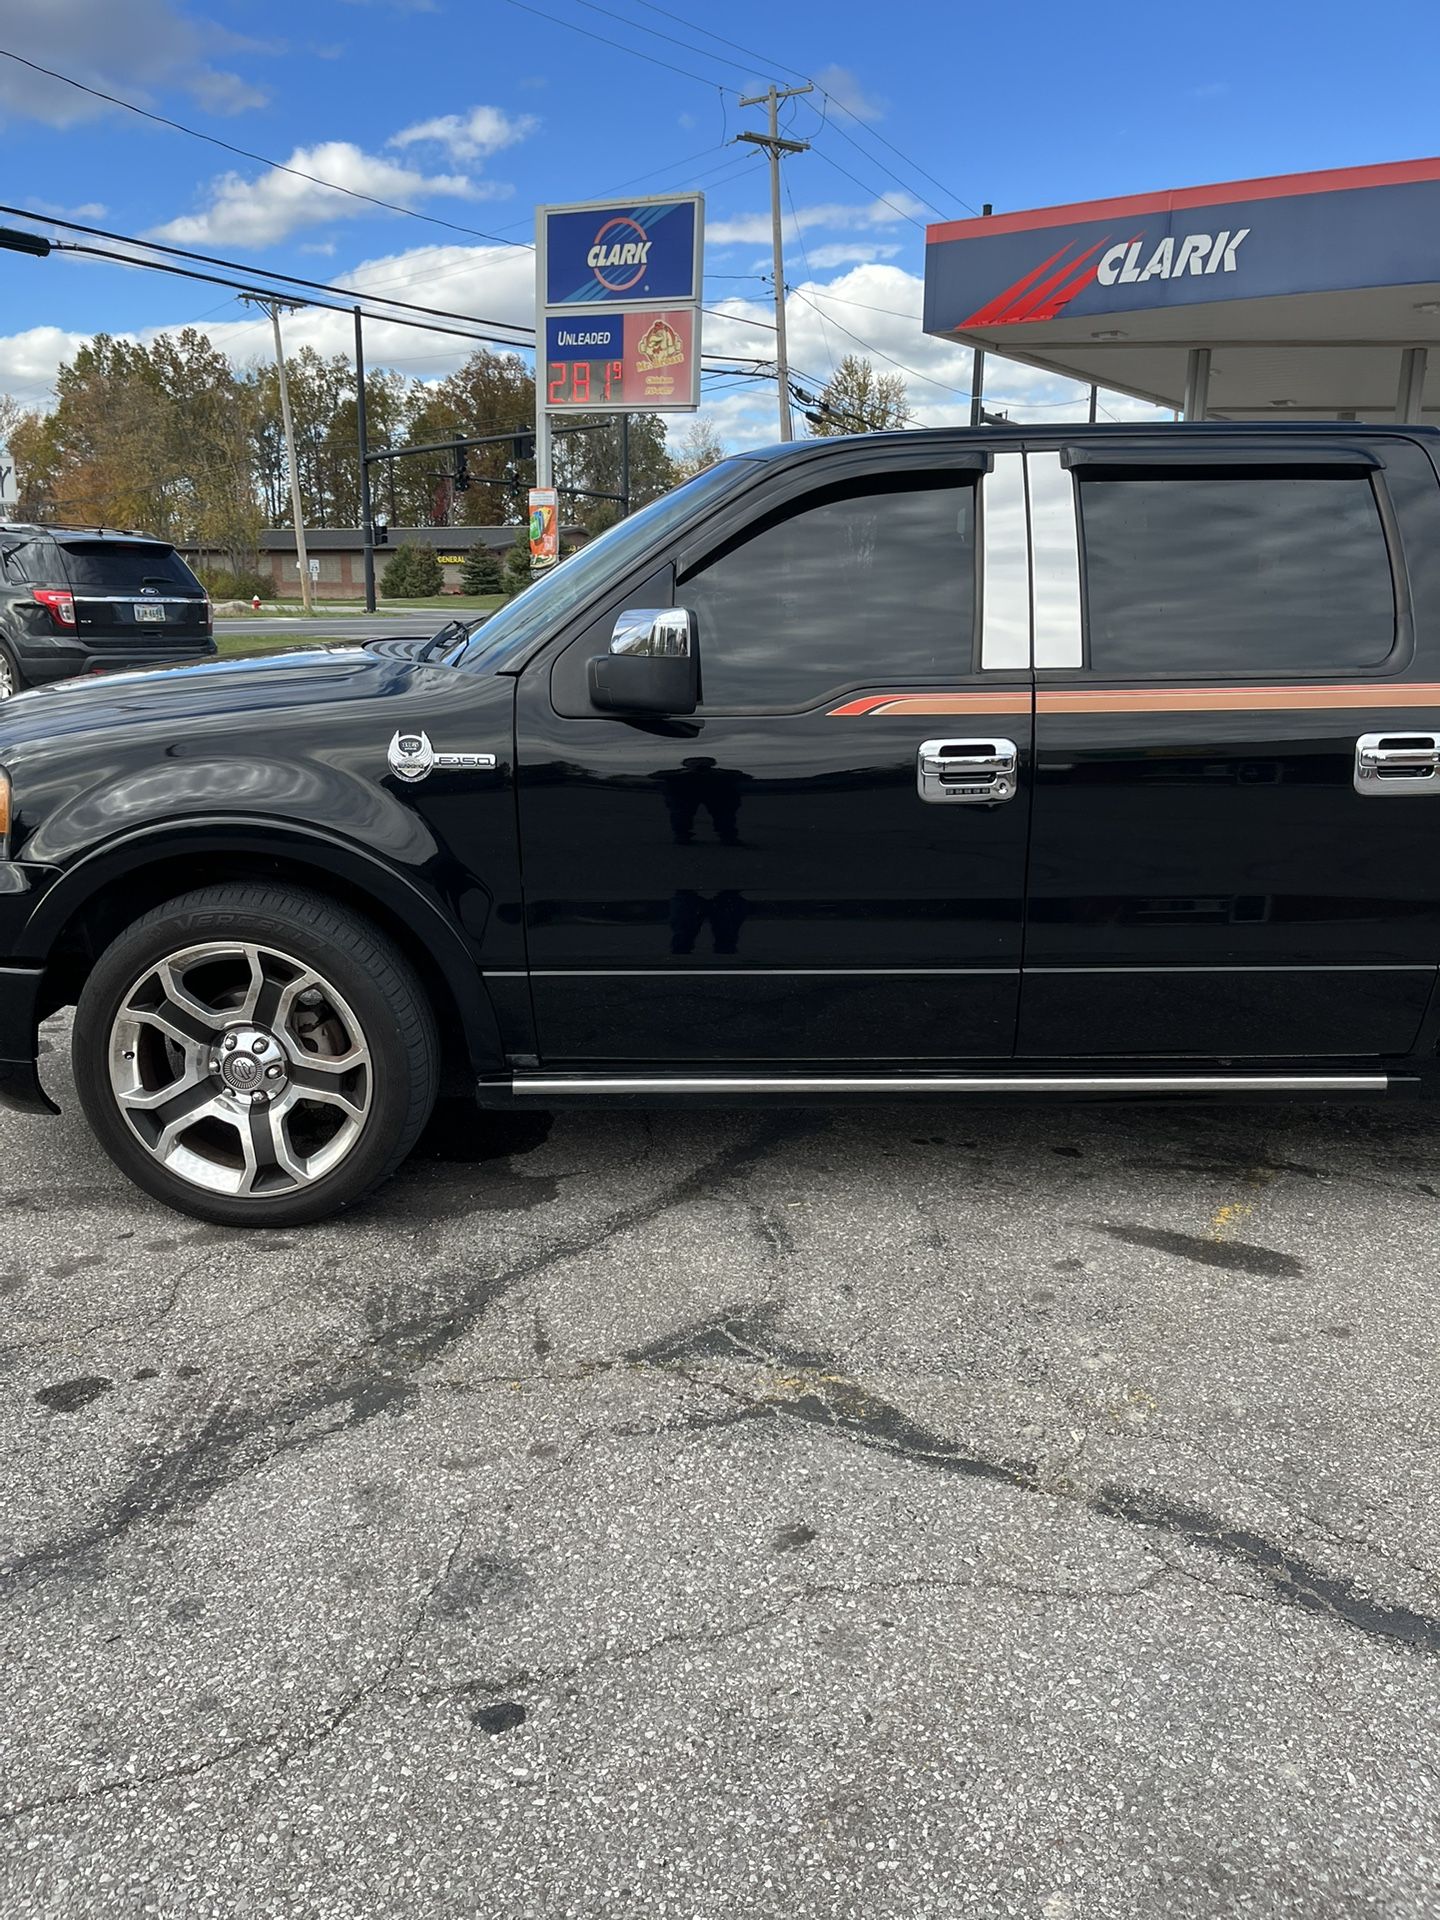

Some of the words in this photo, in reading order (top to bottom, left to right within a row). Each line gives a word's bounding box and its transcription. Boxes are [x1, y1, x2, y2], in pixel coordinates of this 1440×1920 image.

[587, 241, 653, 268] CLARK
[1097, 227, 1251, 287] CLARK
[437, 555, 466, 565] GENERAL
